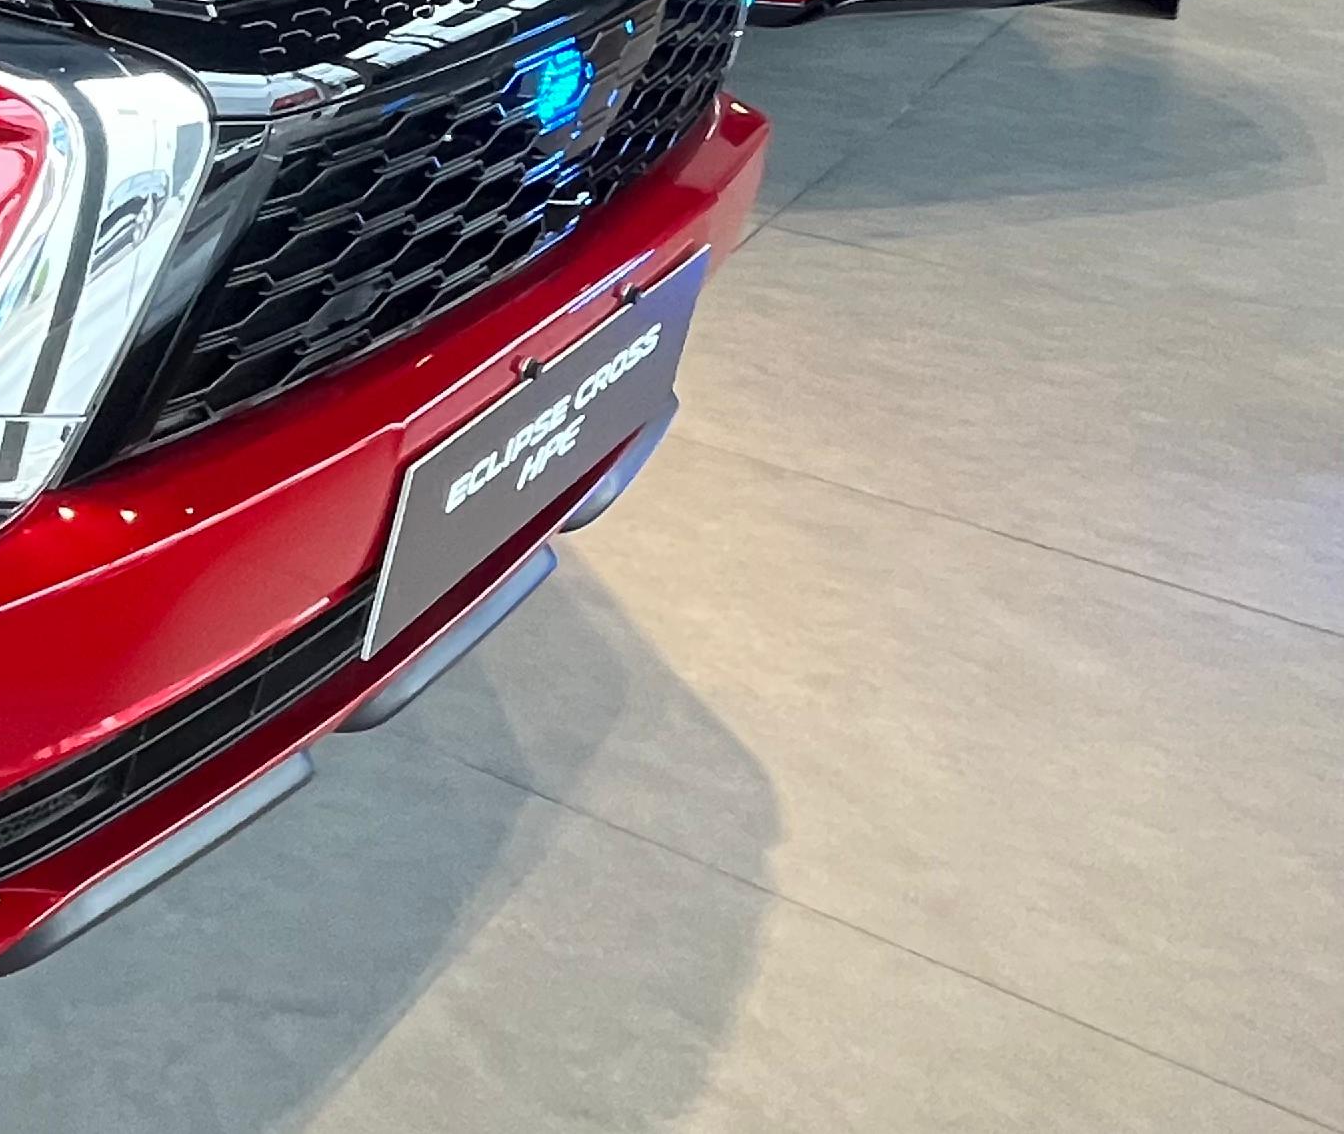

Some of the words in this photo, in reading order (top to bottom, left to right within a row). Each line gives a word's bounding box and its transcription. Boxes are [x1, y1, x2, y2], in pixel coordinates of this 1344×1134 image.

[445, 394, 572, 514] ECLIPSE
[574, 322, 662, 410] CROSS
[516, 414, 586, 491] HPE
